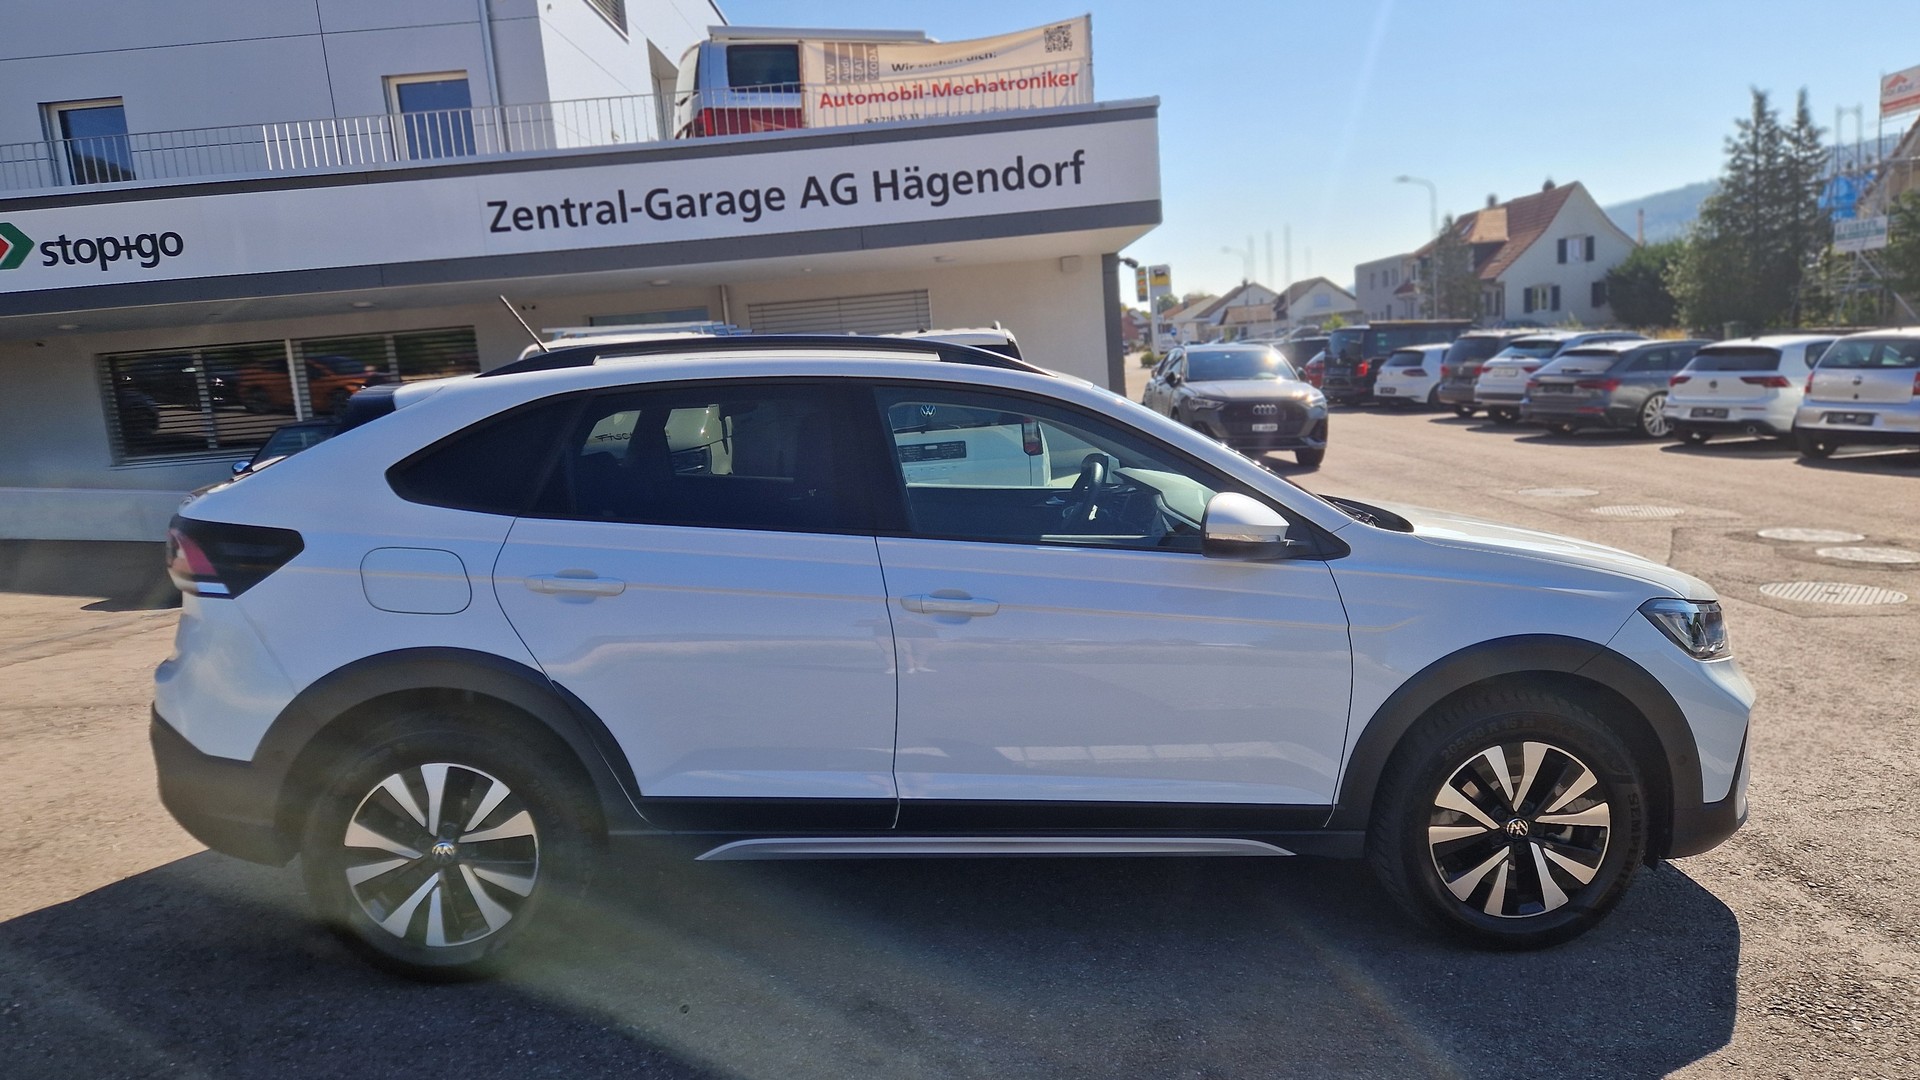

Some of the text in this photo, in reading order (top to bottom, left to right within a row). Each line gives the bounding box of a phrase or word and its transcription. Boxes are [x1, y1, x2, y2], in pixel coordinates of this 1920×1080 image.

[841, 58, 851, 80] Audi
[854, 58, 864, 80] SEAT
[891, 62, 914, 72] Wir
[819, 71, 1079, 109] Automobil-Mechatroniker
[486, 149, 1085, 233] Zentral-Garage AG Hägendorf
[40, 231, 184, 271] stop+go
